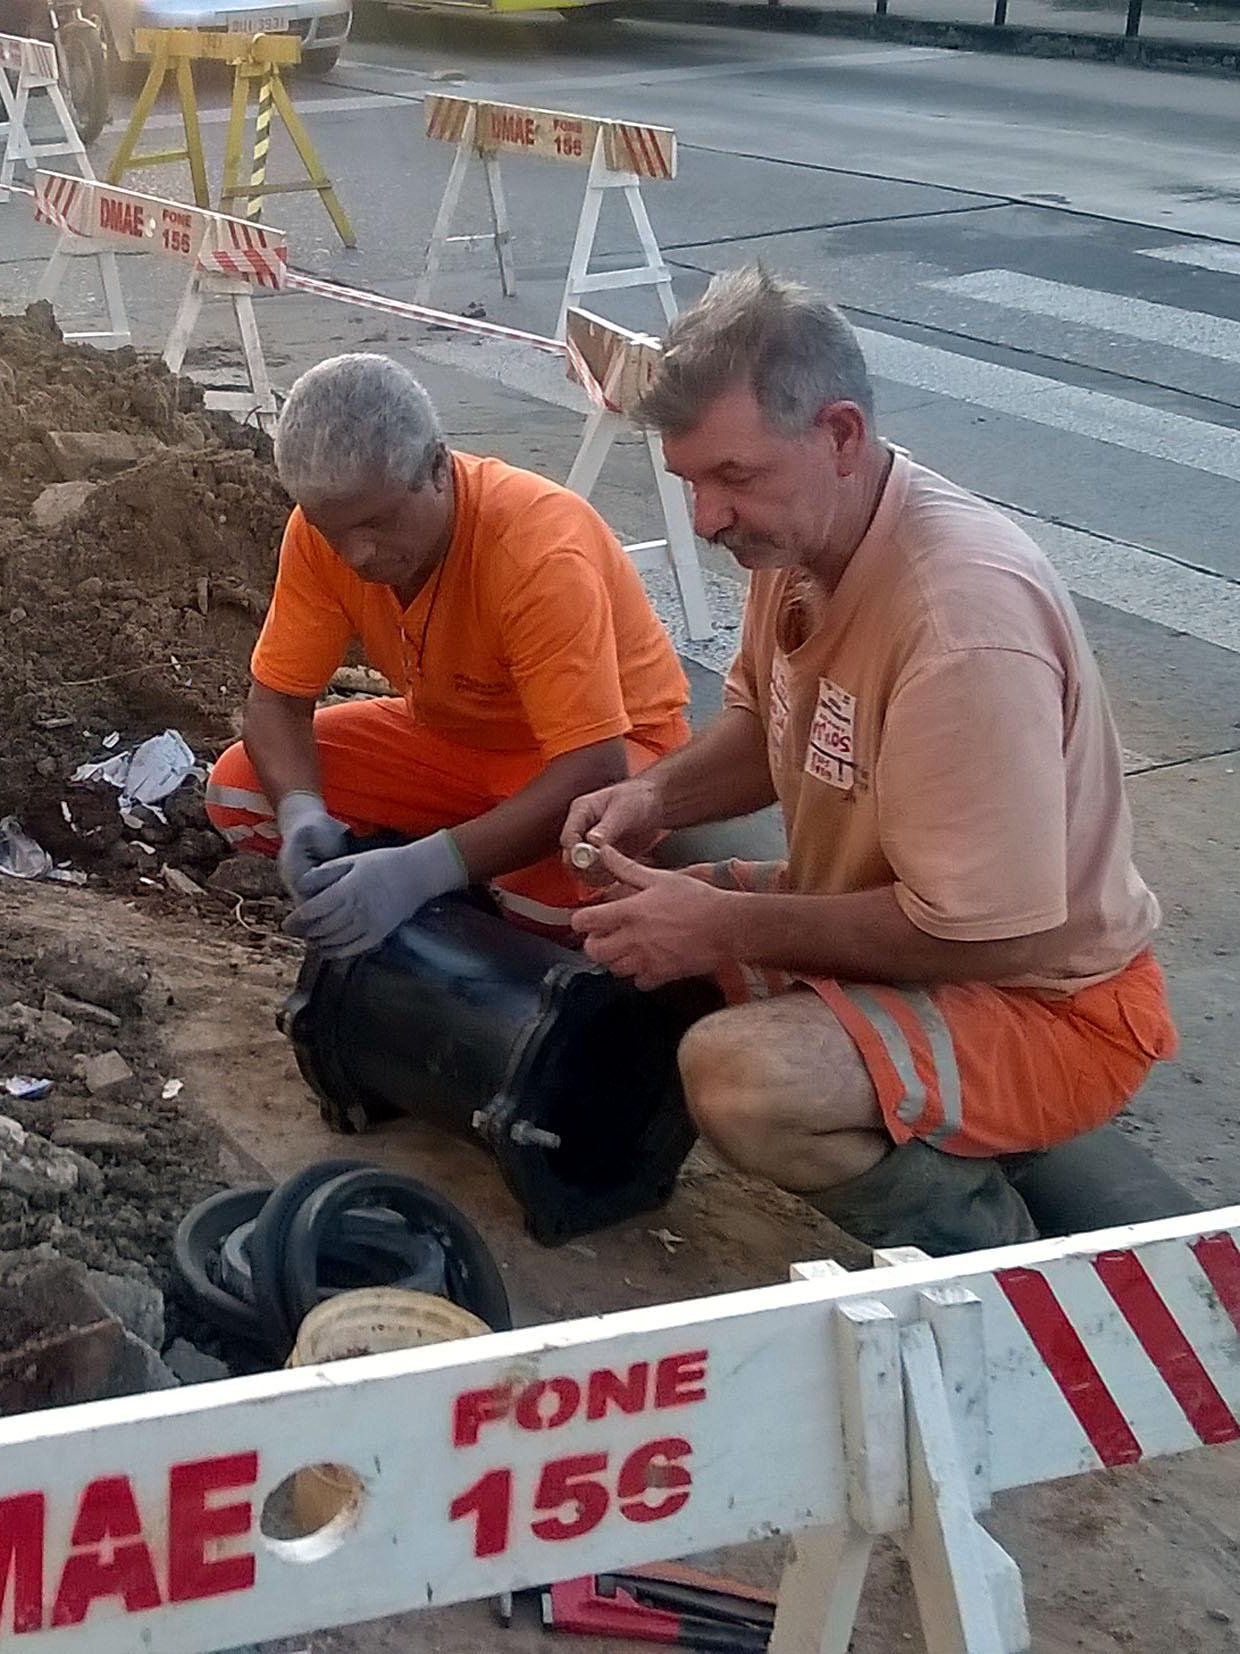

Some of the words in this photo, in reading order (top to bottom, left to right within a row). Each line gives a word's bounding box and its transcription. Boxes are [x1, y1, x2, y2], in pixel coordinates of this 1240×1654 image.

[100, 197, 144, 238] DMAE
[162, 208, 192, 227] FONE
[162, 229, 191, 253] 156
[452, 1350, 709, 1447] FONE
[449, 1438, 694, 1559] 156
